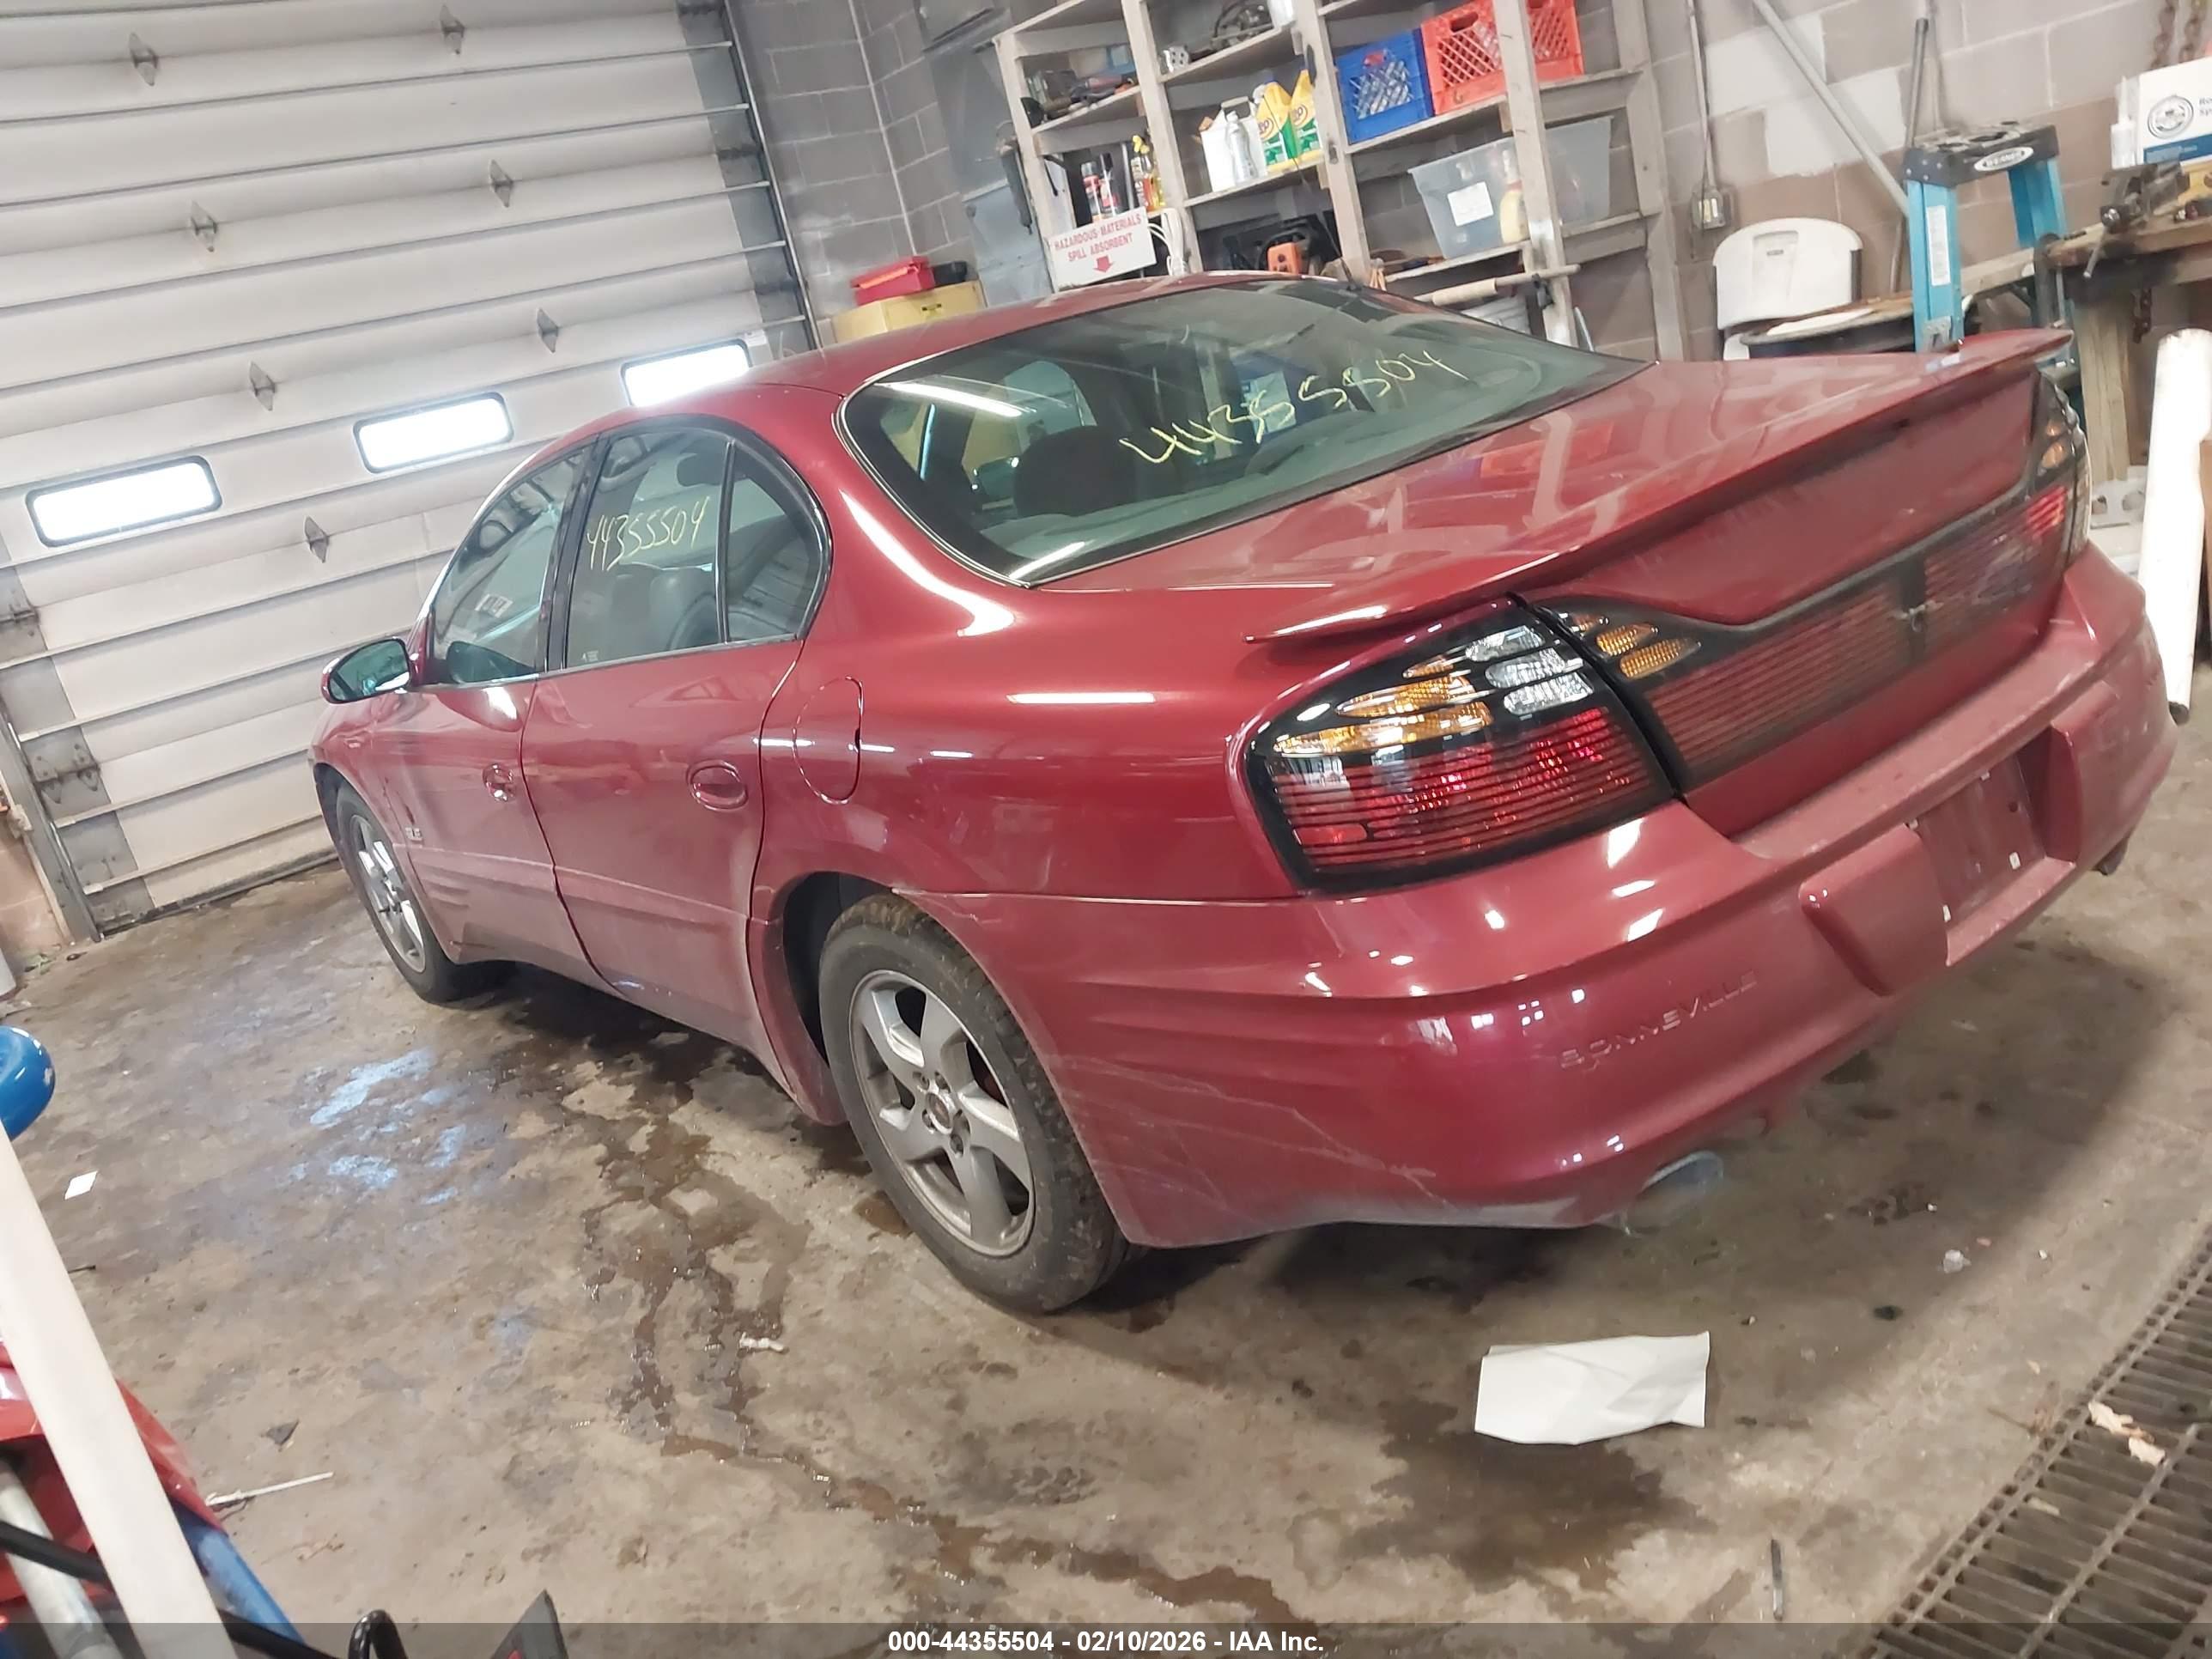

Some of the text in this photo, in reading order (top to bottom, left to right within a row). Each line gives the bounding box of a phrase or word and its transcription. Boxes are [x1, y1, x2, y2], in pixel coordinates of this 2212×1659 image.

[1054, 213, 1141, 251] HAZARDOUS MATERIALS
[1067, 233, 1133, 262] SPILL ABSORBENT
[586, 495, 711, 572] 44355504
